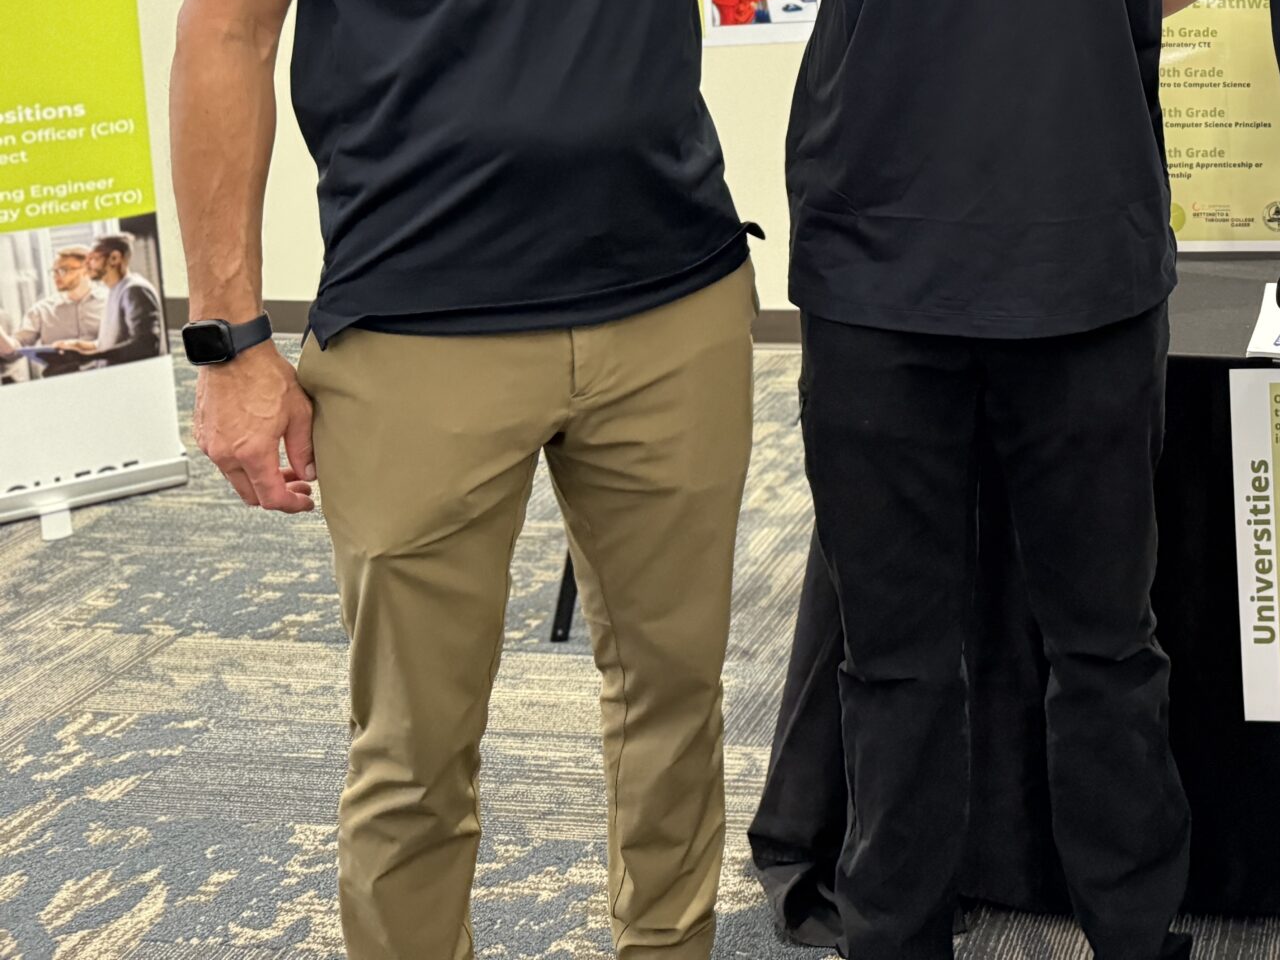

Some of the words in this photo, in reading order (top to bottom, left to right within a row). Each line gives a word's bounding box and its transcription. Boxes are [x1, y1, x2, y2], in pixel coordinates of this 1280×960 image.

[1178, 27, 1218, 38] Grade
[1184, 67, 1223, 78] Grade
[1183, 81, 1221, 89] Computer
[0, 102, 86, 125] sitions
[1186, 107, 1225, 118] Grade
[1165, 121, 1202, 129] Computer
[1234, 121, 1272, 129] Principles
[22, 126, 86, 145] Officer
[91, 118, 135, 139] (CIO)
[1186, 147, 1225, 158] Grade
[1195, 161, 1253, 170] Apprenticeship
[30, 177, 114, 198] Engineer
[25, 199, 89, 217] Officer
[94, 189, 143, 210] (CTO)
[1246, 459, 1276, 645] Universities
